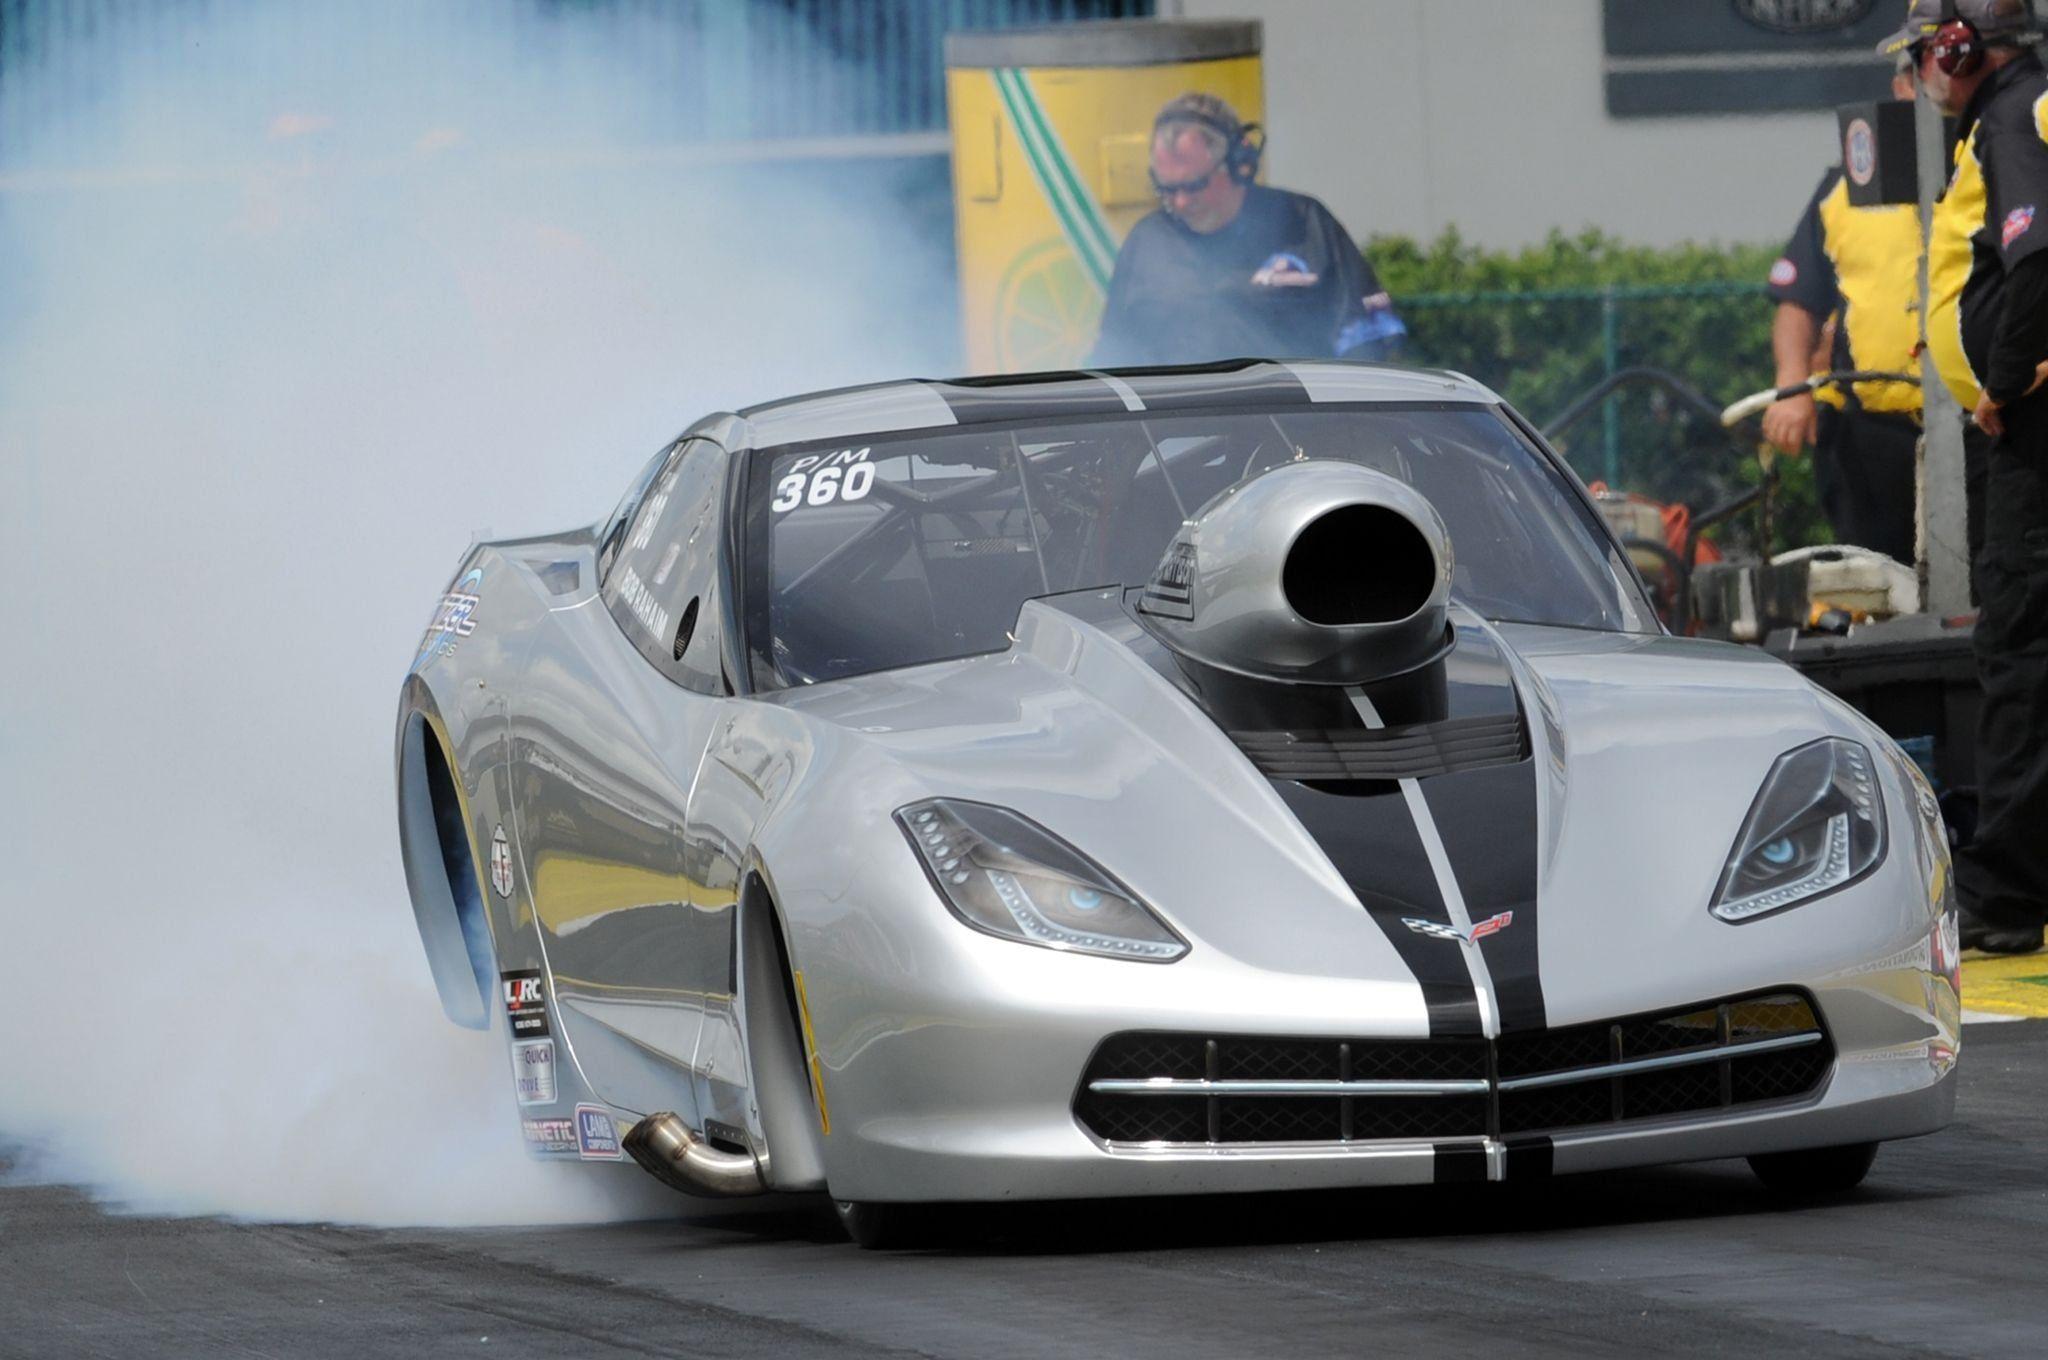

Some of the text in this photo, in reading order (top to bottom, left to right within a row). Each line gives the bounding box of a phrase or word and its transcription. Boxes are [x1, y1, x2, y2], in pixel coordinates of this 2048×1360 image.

[789, 447, 871, 474] P/M
[772, 461, 876, 513] 360
[525, 1049, 550, 1064] QUICK
